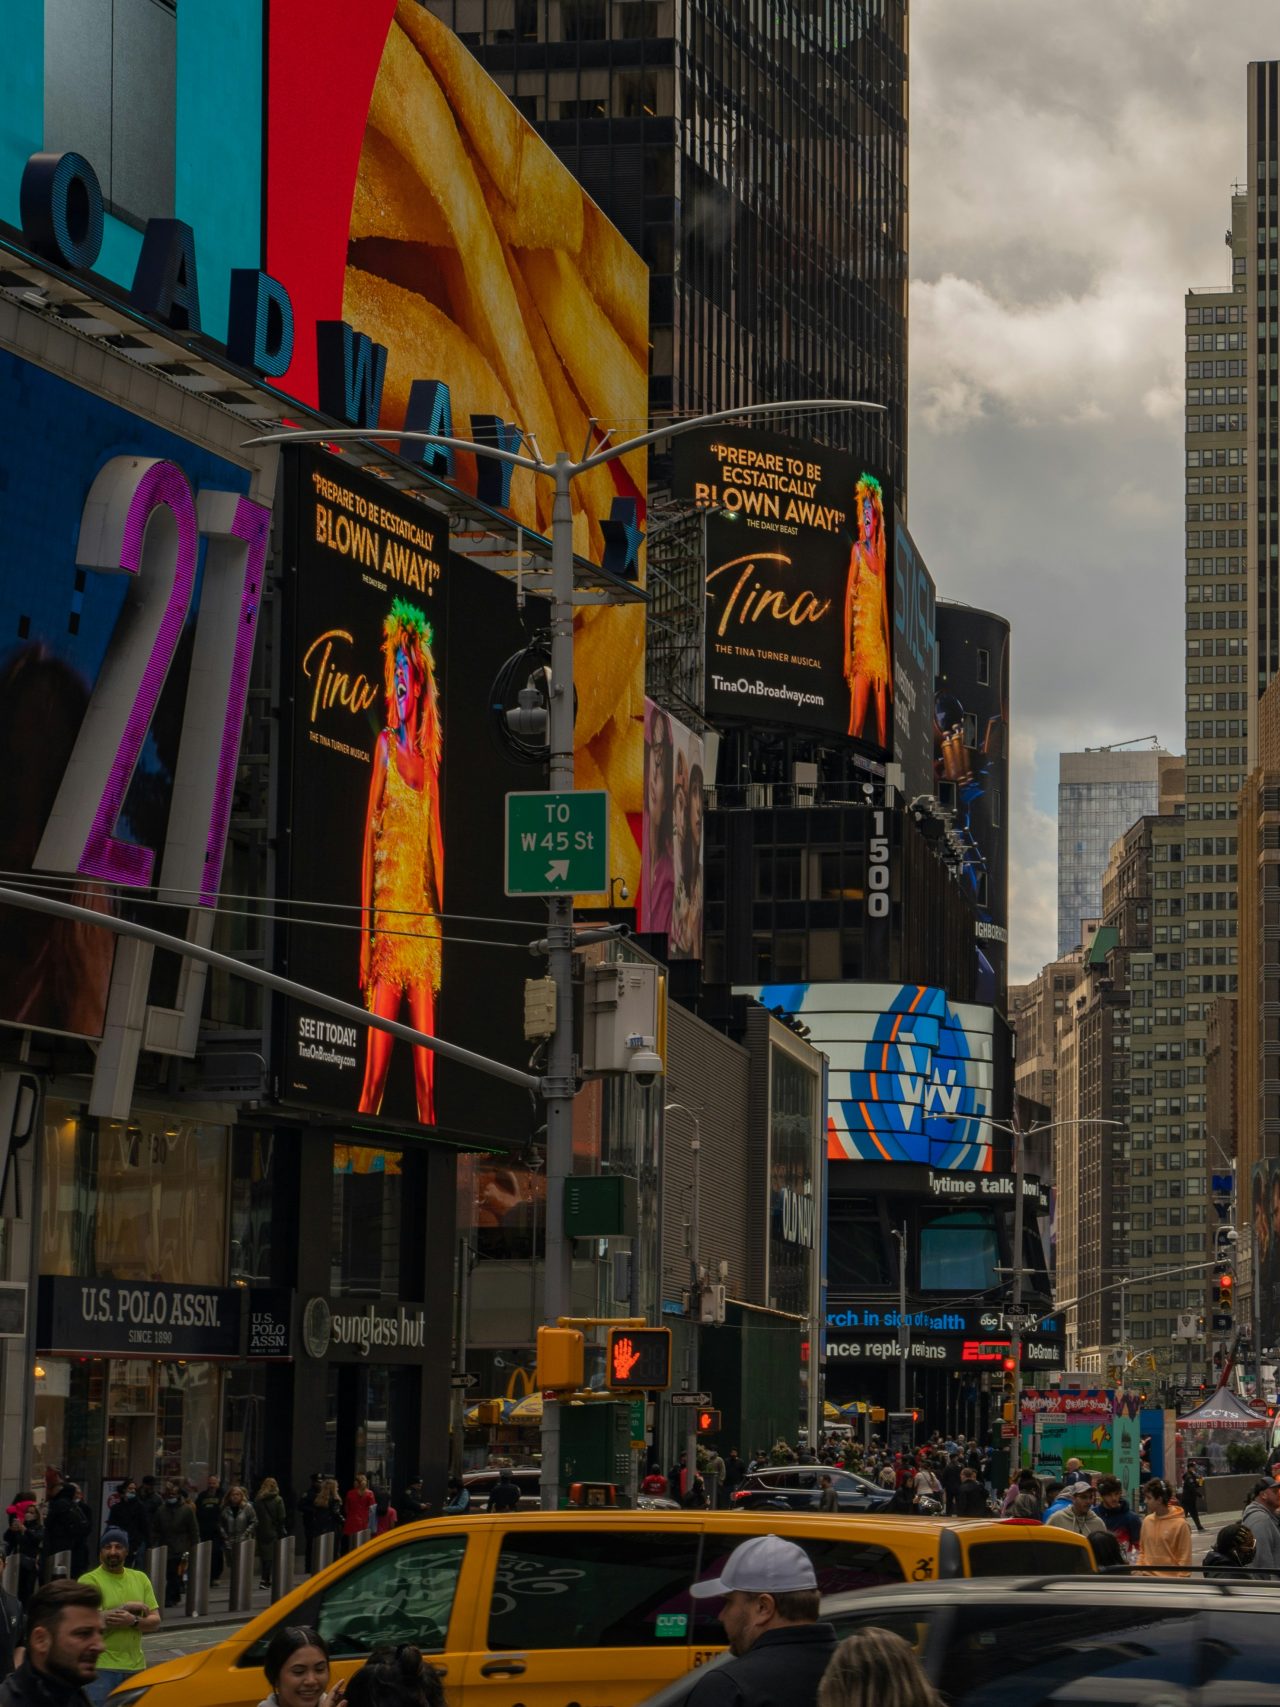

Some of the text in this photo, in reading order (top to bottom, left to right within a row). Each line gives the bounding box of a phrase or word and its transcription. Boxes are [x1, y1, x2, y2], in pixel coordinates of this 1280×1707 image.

[722, 466, 817, 499] ECSTATICALLY
[786, 458, 803, 476] TO
[806, 464, 822, 482] BE
[695, 482, 781, 520] BLOWN
[316, 503, 379, 571] BLOWN
[355, 495, 368, 518] TO
[368, 502, 379, 525] BE
[380, 508, 434, 552] ECSTATICALLY
[747, 518, 798, 536] THE DAILY BEAST
[705, 551, 832, 637] Tina
[715, 644, 822, 669] THE TINA TURNER MUSICAL
[303, 629, 379, 723] Tina
[711, 674, 824, 706] TinaOnBroadway.com
[544, 803, 570, 824] TO
[521, 830, 594, 852] W 45 St
[868, 811, 890, 918] 1500
[300, 1016, 356, 1048] SEE IT TODAY!
[298, 1042, 356, 1070] TinaOnBroadway.com
[980, 1178, 1015, 1194] talk
[783, 1186, 798, 1243] OLD
[82, 1287, 221, 1328] U.S. POLO ASSN.
[252, 1312, 275, 1325] U.S.
[864, 1310, 880, 1326] in
[128, 1330, 172, 1346] SINCE 1890
[250, 1334, 288, 1348] ASSN.
[251, 1322, 286, 1337] POLO
[331, 1304, 426, 1357] sunglass hut
[656, 1614, 688, 1627] curb
